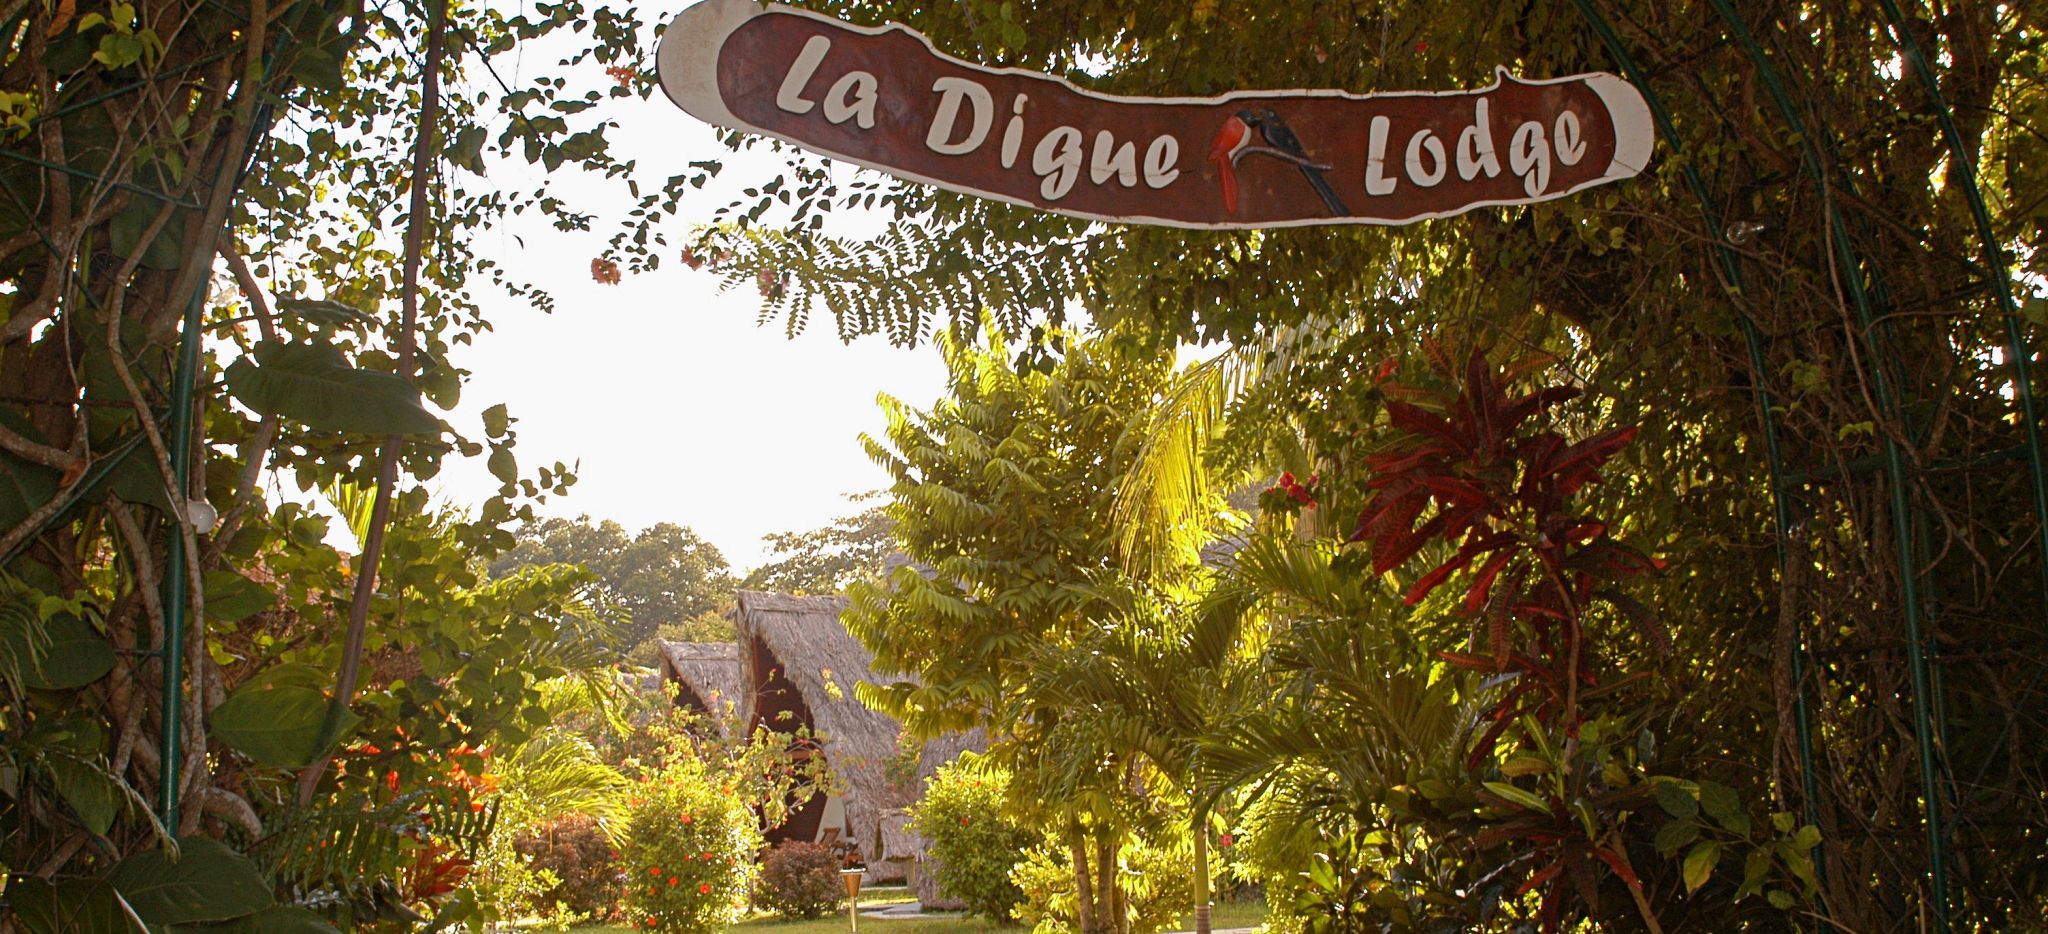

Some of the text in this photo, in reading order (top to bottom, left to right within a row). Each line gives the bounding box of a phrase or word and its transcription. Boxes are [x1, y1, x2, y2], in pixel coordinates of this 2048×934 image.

[776, 35, 1587, 200] La Digue Lodge
